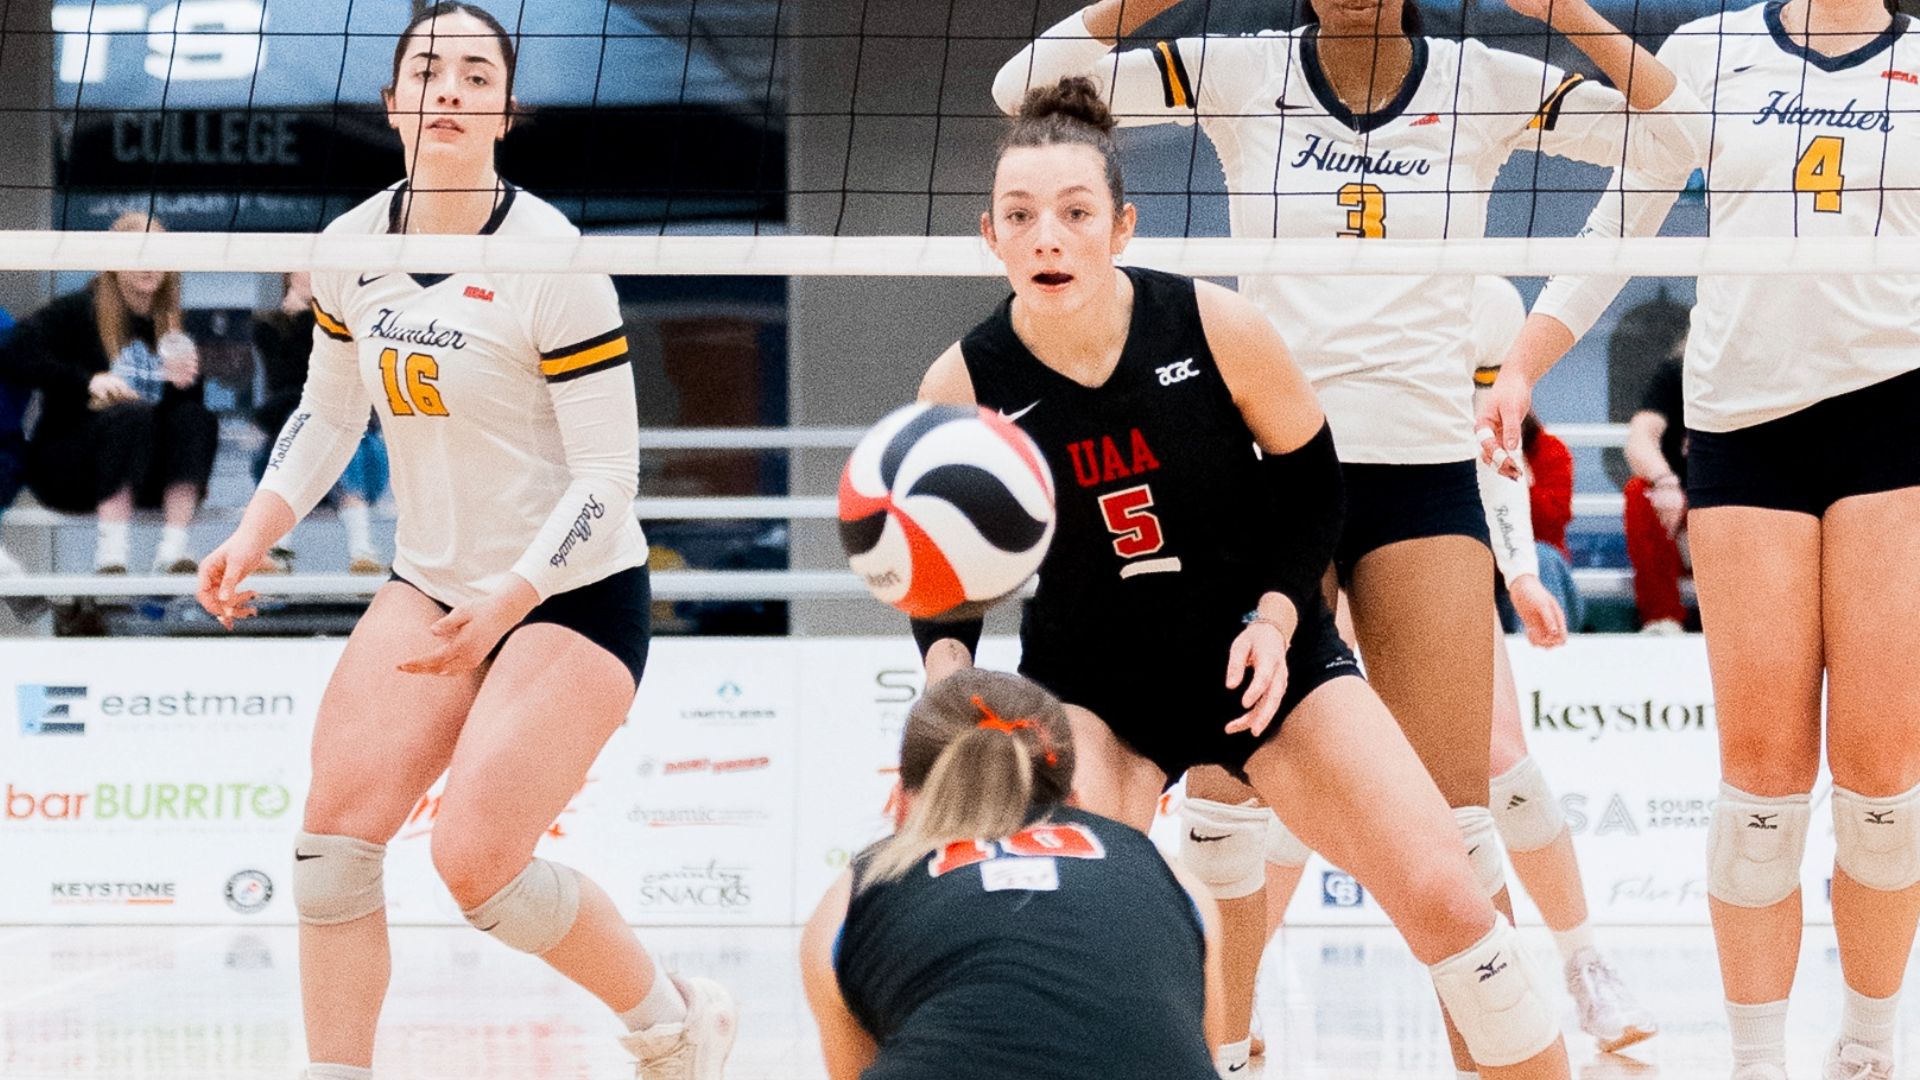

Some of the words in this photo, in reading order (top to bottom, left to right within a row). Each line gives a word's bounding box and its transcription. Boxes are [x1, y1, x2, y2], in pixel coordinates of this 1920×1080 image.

[1753, 90, 1894, 133] Humber
[112, 112, 299, 163] COLLEGE
[1291, 133, 1431, 176] Humber
[1793, 135, 1845, 214] 4
[1336, 182, 1387, 238] 3
[369, 308, 467, 350] Humber
[379, 347, 449, 417] 16
[1067, 427, 1160, 487] UAA
[1097, 483, 1164, 559] 5
[100, 690, 294, 717] eastman
[51, 882, 175, 896] KEYSTONE
[640, 885, 751, 906] SNACKS
